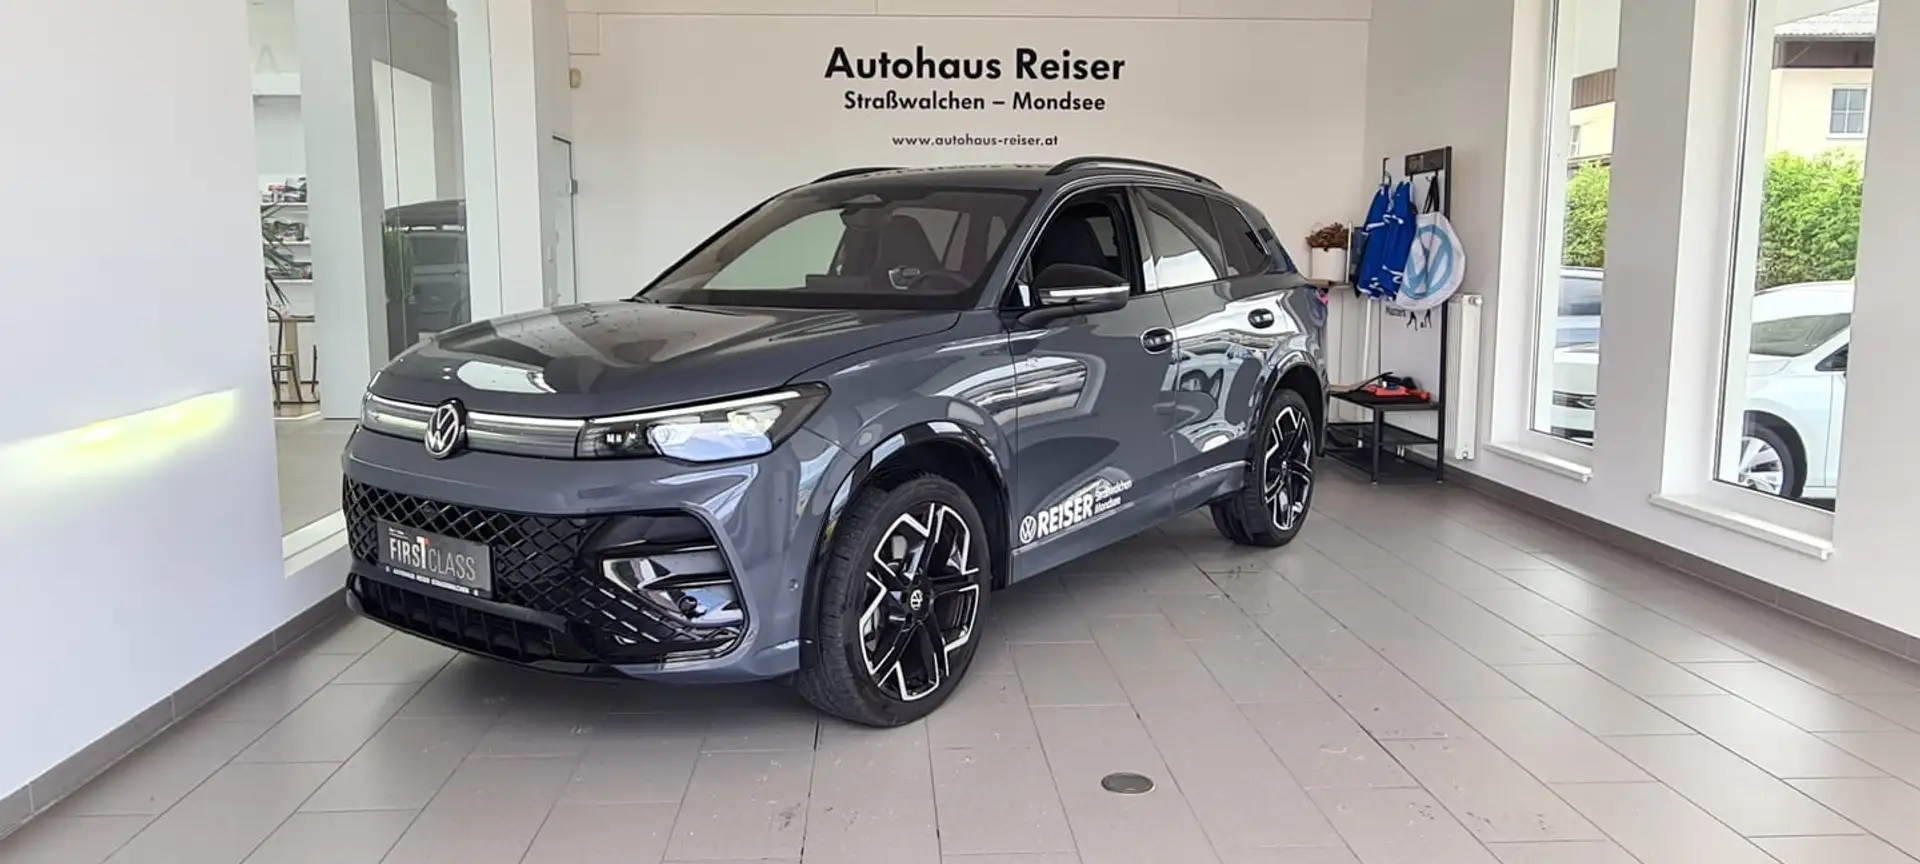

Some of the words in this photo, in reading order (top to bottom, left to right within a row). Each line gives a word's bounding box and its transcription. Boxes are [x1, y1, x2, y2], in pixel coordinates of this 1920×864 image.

[824, 46, 1001, 79] Autohaus
[1016, 48, 1125, 80] Reiser
[845, 90, 984, 109] Straßwalchen
[1013, 91, 1105, 110] Mondsee
[893, 134, 1057, 145] www.autohaus-reiser.at
[1038, 493, 1093, 538] REISER
